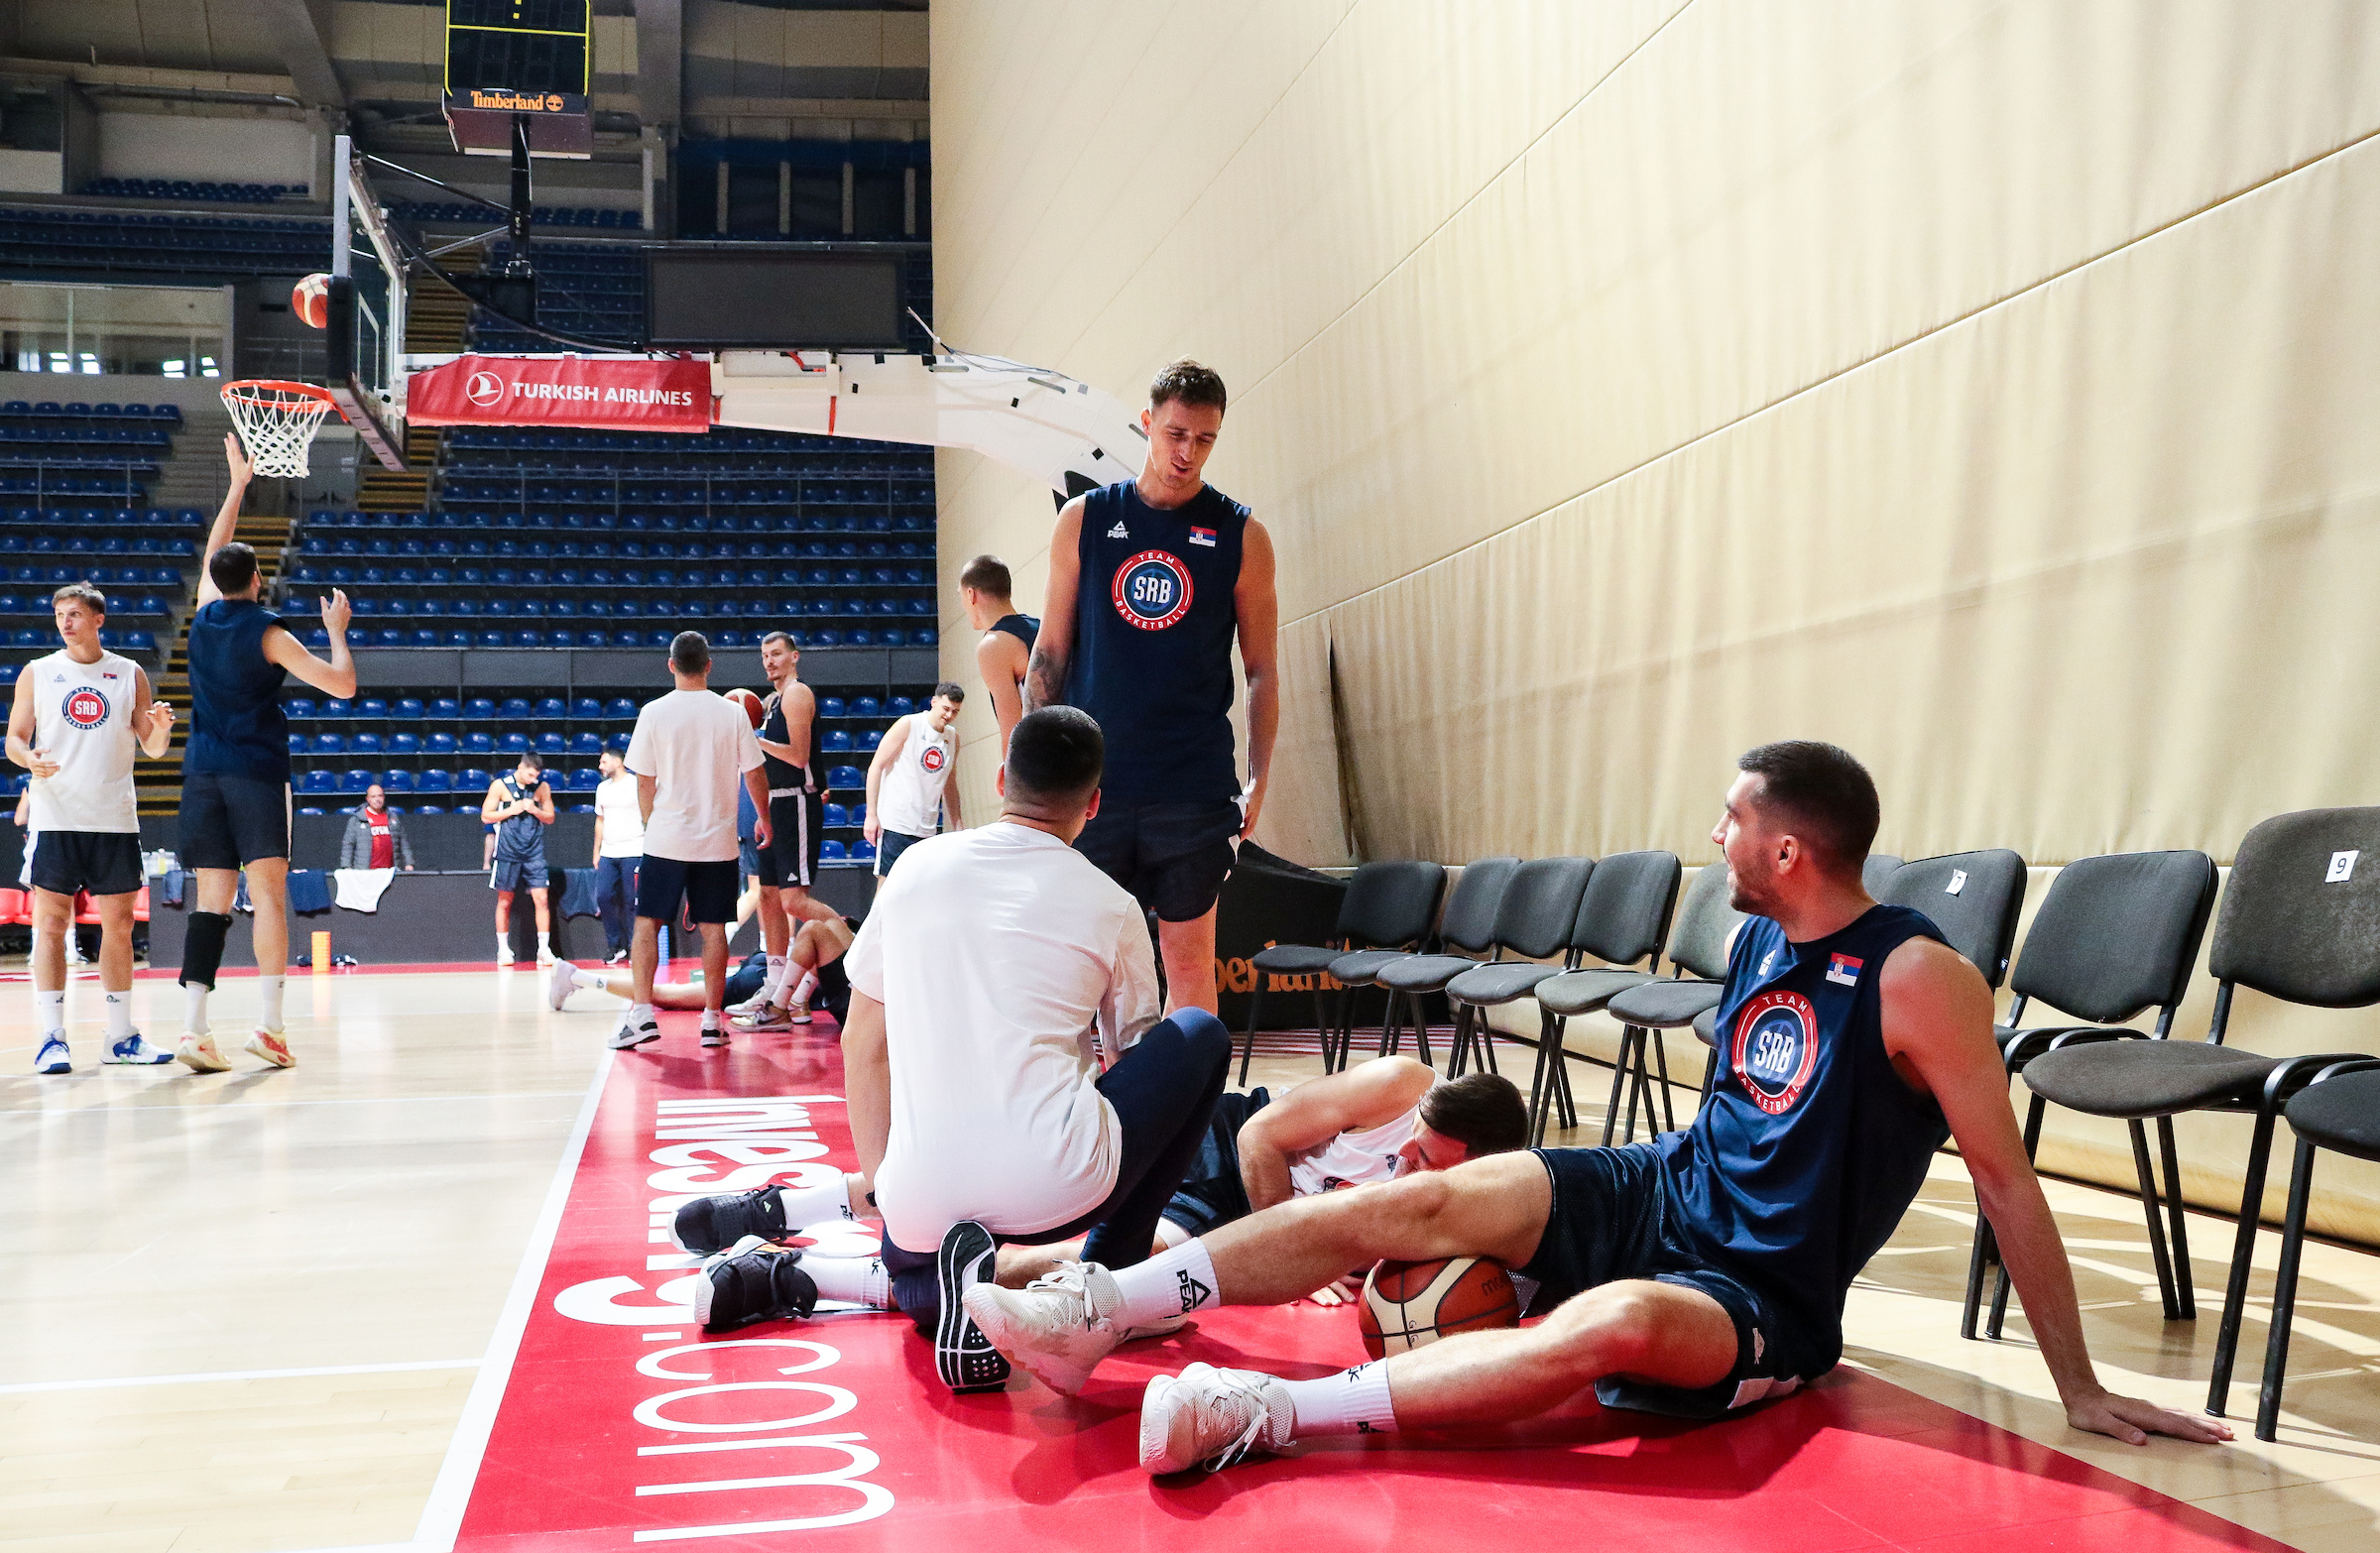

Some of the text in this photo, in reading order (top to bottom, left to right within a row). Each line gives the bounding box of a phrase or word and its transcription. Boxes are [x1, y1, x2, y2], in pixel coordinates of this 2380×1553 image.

[470, 90, 544, 111] Timberland
[512, 382, 692, 407] TURKISH AIRLINES
[1107, 529, 1130, 539] PEAK
[1138, 551, 1175, 565] TEAM
[1132, 575, 1172, 604] SRB
[1116, 599, 1186, 630] BASKETBALL
[74, 700, 98, 716] SRB
[2335, 857, 2347, 875] 9
[1762, 994, 1808, 1014] TEAM
[1754, 1029, 1796, 1074] SRB
[1733, 1064, 1801, 1113] BASKETBALL
[552, 1094, 896, 1544] Invesng.com
